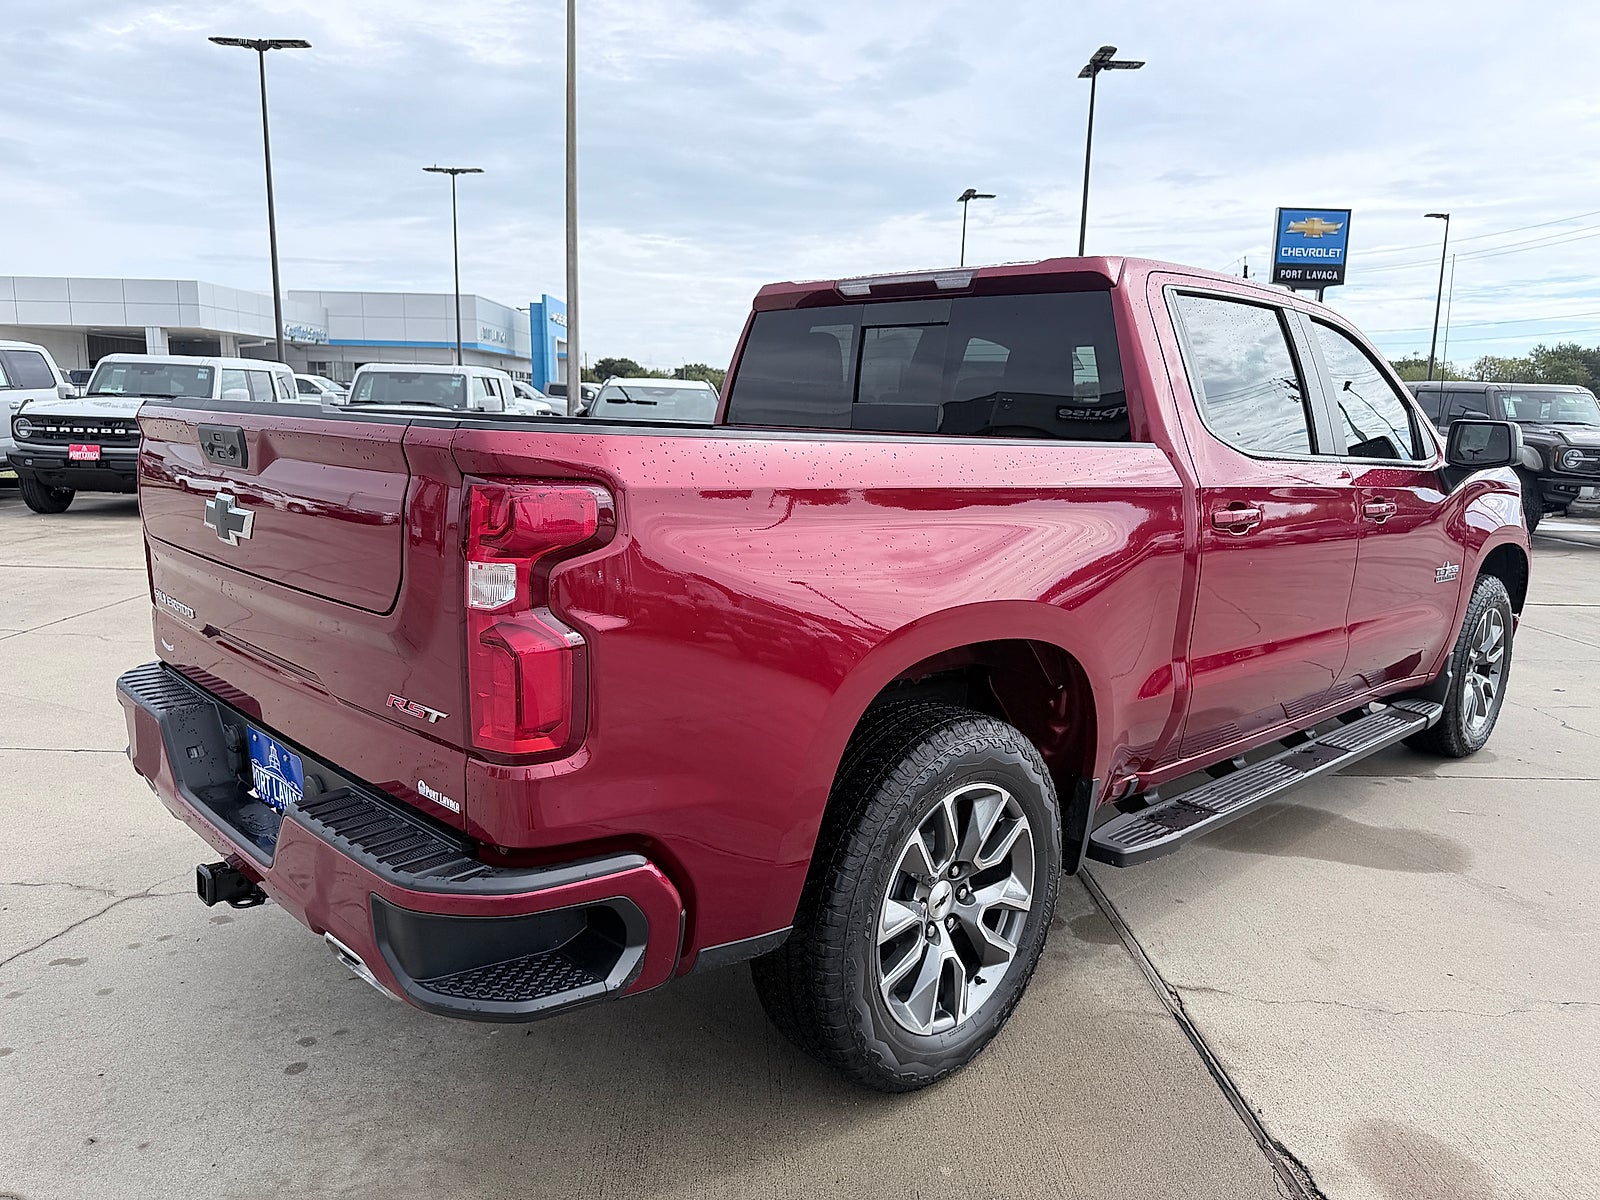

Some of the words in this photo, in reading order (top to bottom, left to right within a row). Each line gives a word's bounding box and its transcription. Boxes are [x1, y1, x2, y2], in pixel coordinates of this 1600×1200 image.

[1281, 247, 1342, 258] CHEVROLET
[1280, 269, 1303, 279] PORT
[1306, 270, 1339, 280] LAVACA
[46, 426, 126, 434] BRONCO
[386, 692, 450, 724] RST
